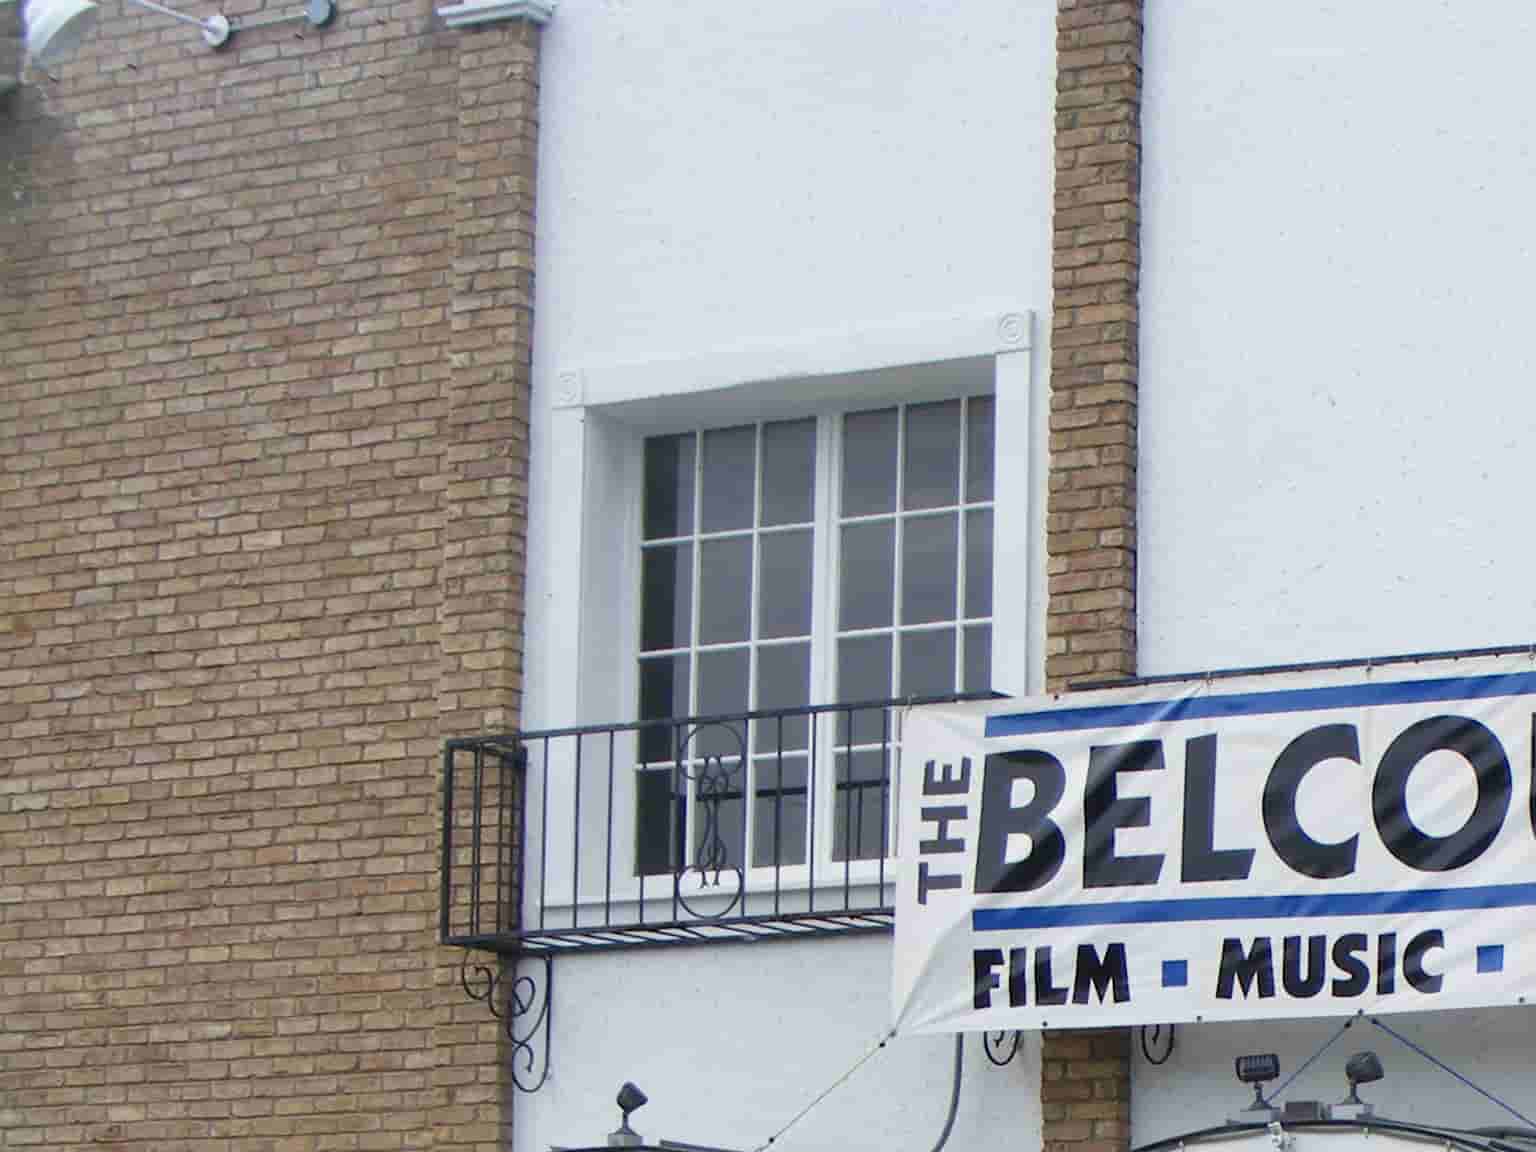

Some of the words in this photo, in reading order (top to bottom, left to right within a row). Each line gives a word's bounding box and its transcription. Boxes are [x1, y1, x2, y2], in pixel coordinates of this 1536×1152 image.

[918, 756, 970, 905] THE
[973, 942, 1130, 1009] FILM
[1215, 929, 1445, 999] MUSIC
